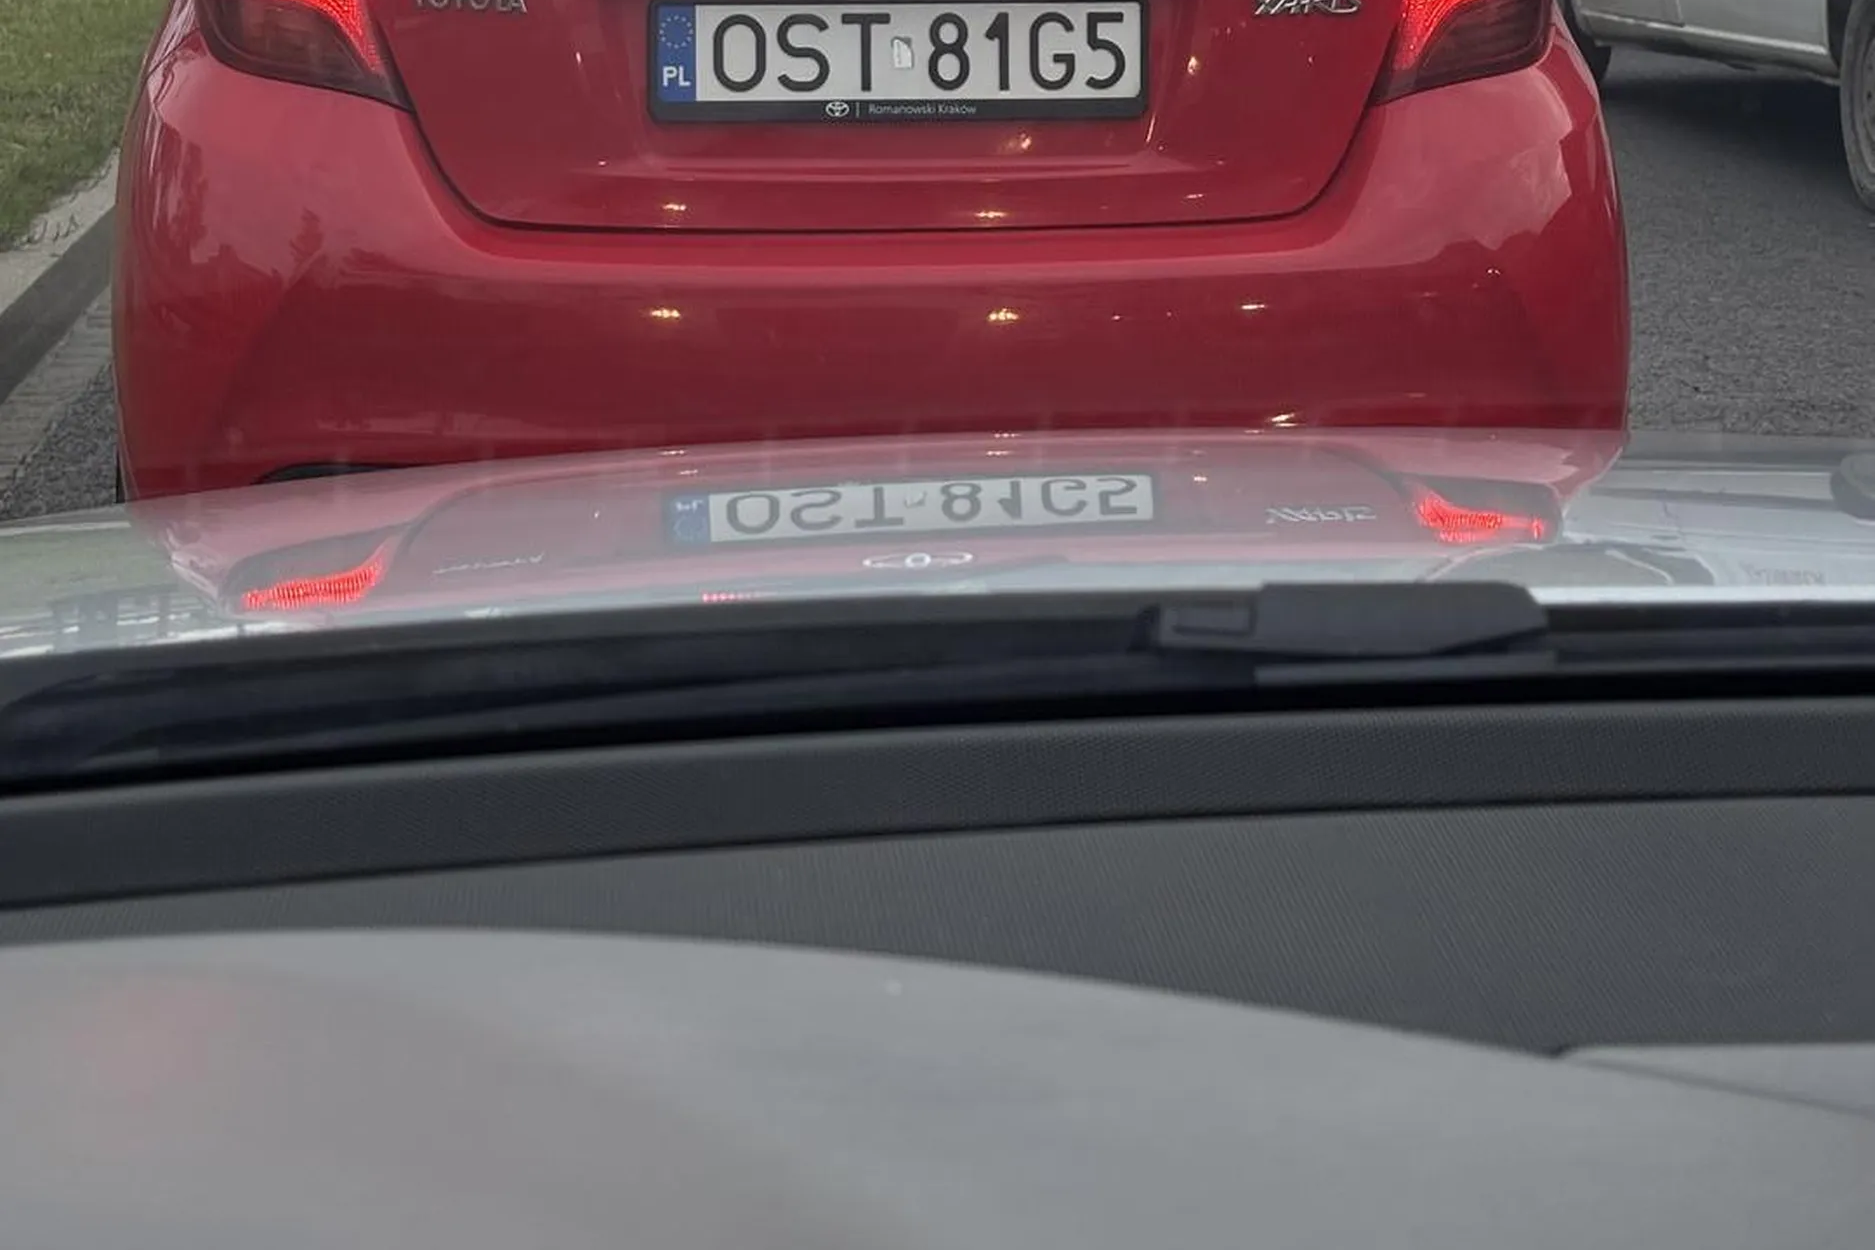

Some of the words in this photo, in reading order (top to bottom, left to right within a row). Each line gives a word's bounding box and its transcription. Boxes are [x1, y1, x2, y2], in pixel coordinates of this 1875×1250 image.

[712, 11, 891, 92] OST
[927, 11, 1126, 91] 81G5
[662, 65, 691, 87] PL
[868, 102, 934, 115] Romanowski
[937, 101, 977, 115] Kraków
